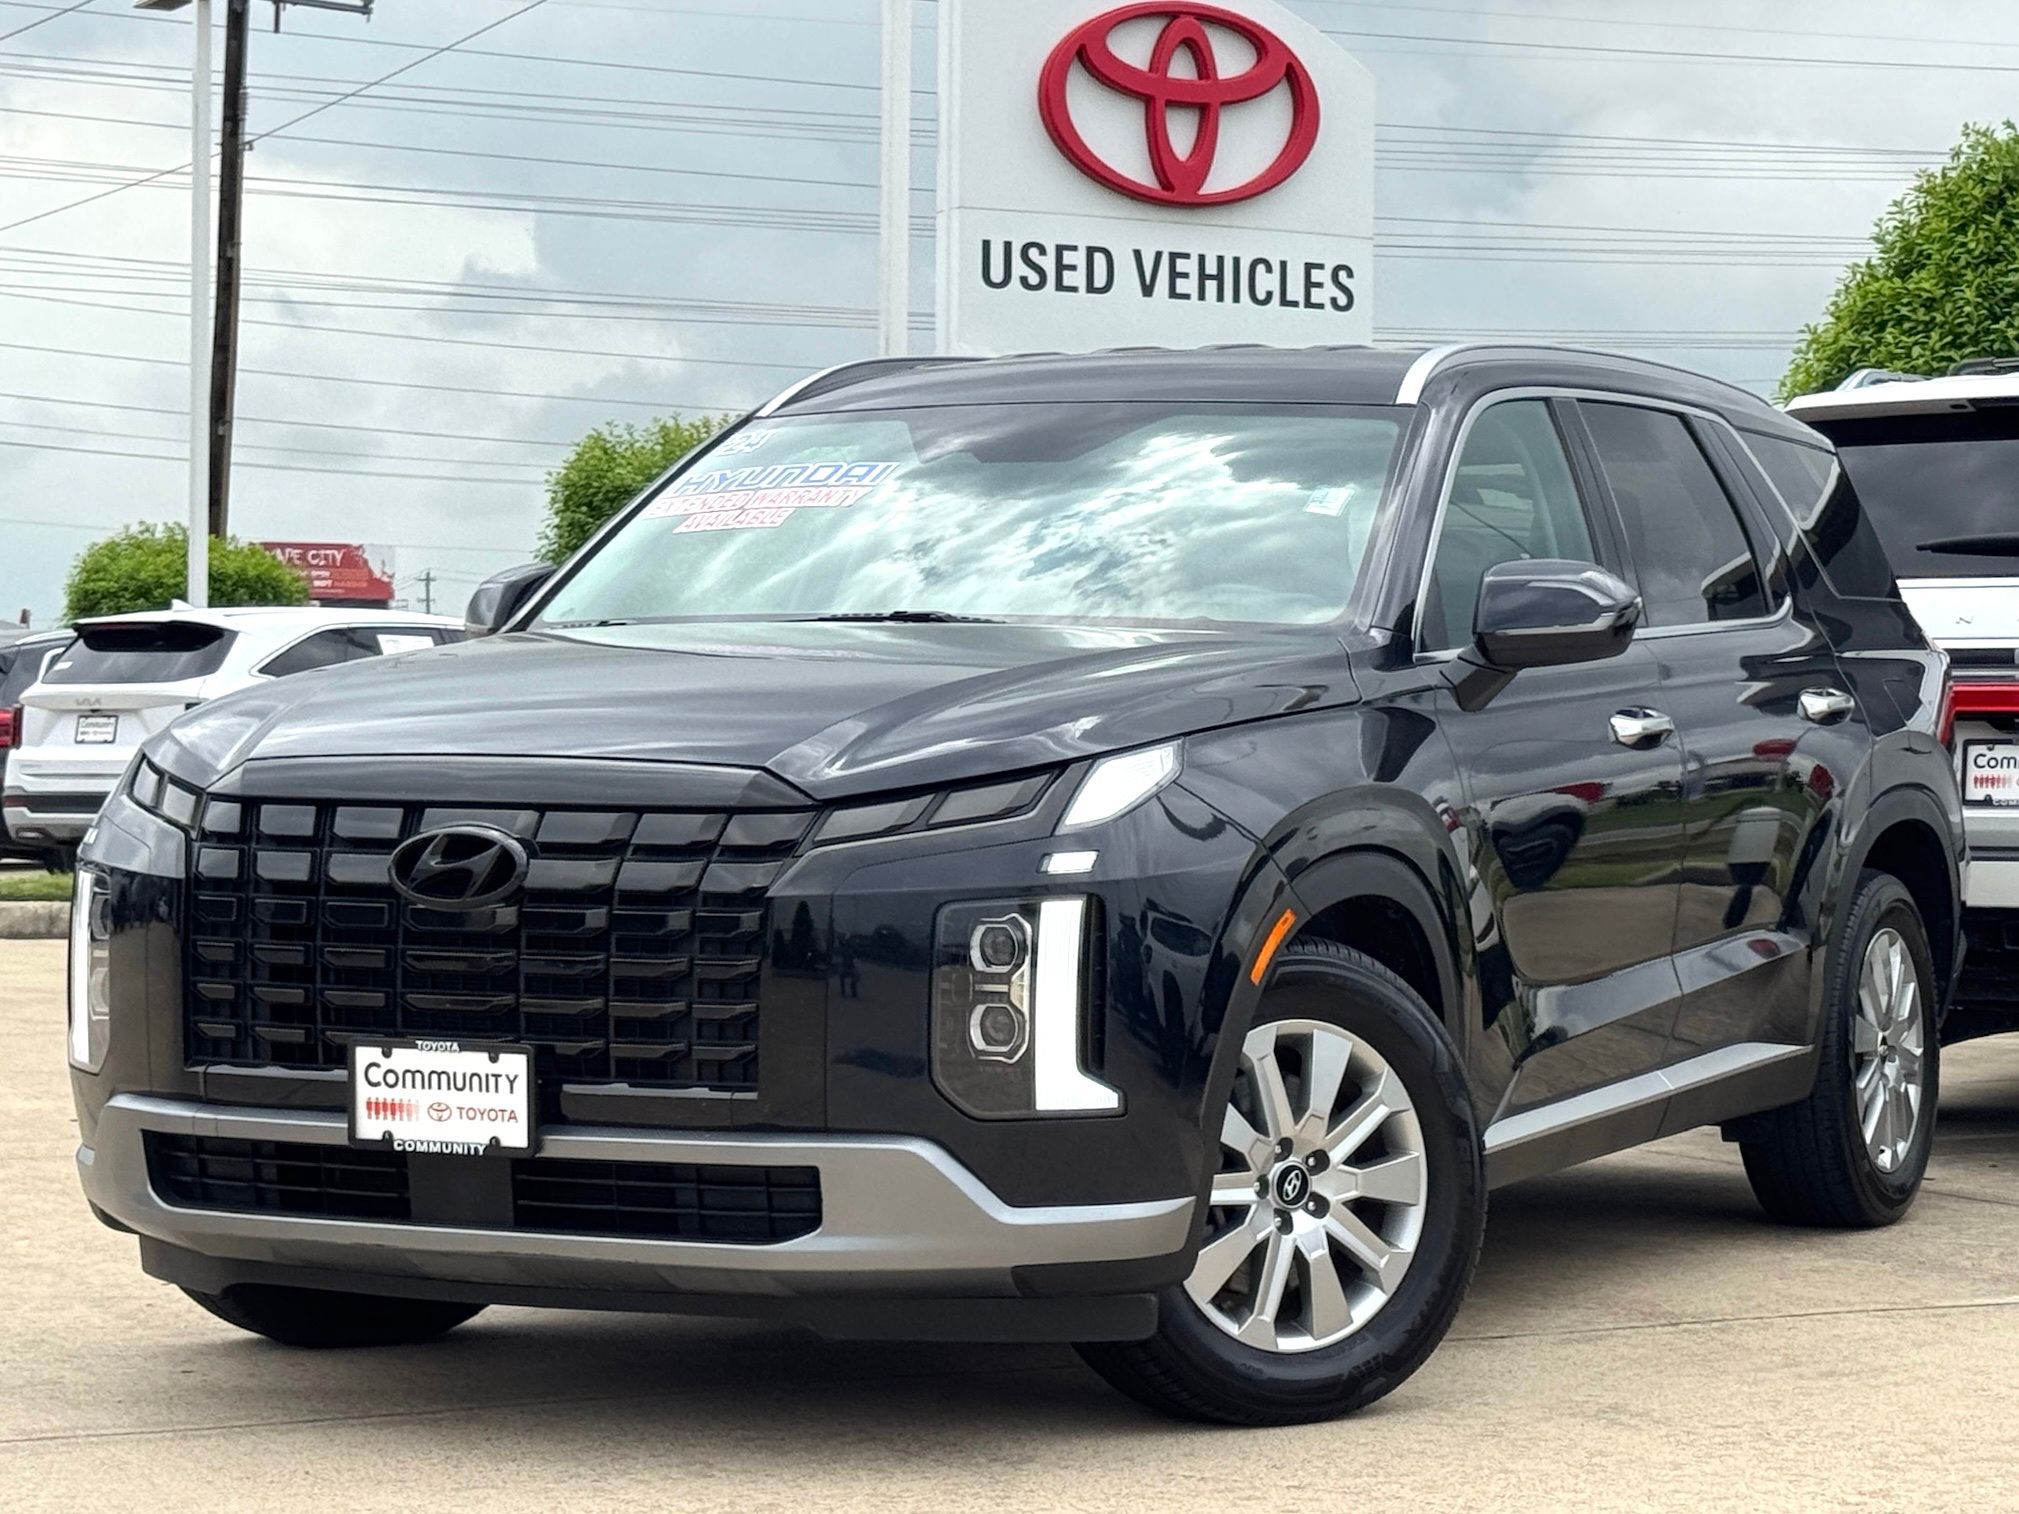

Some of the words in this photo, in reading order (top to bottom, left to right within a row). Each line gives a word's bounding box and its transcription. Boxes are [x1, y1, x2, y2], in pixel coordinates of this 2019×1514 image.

[981, 238, 1115, 295] USED
[1132, 248, 1355, 312] VEHICLES
[671, 462, 899, 496] HYUNDAI
[648, 490, 752, 516] EXTENDED
[749, 487, 862, 507] WARRANTY
[682, 508, 791, 530] AVAILABLE
[307, 549, 346, 567] CITY
[416, 1040, 461, 1053] TOYOTA
[457, 1106, 519, 1124] TOYOTA
[393, 1139, 487, 1156] COMMUNITY
